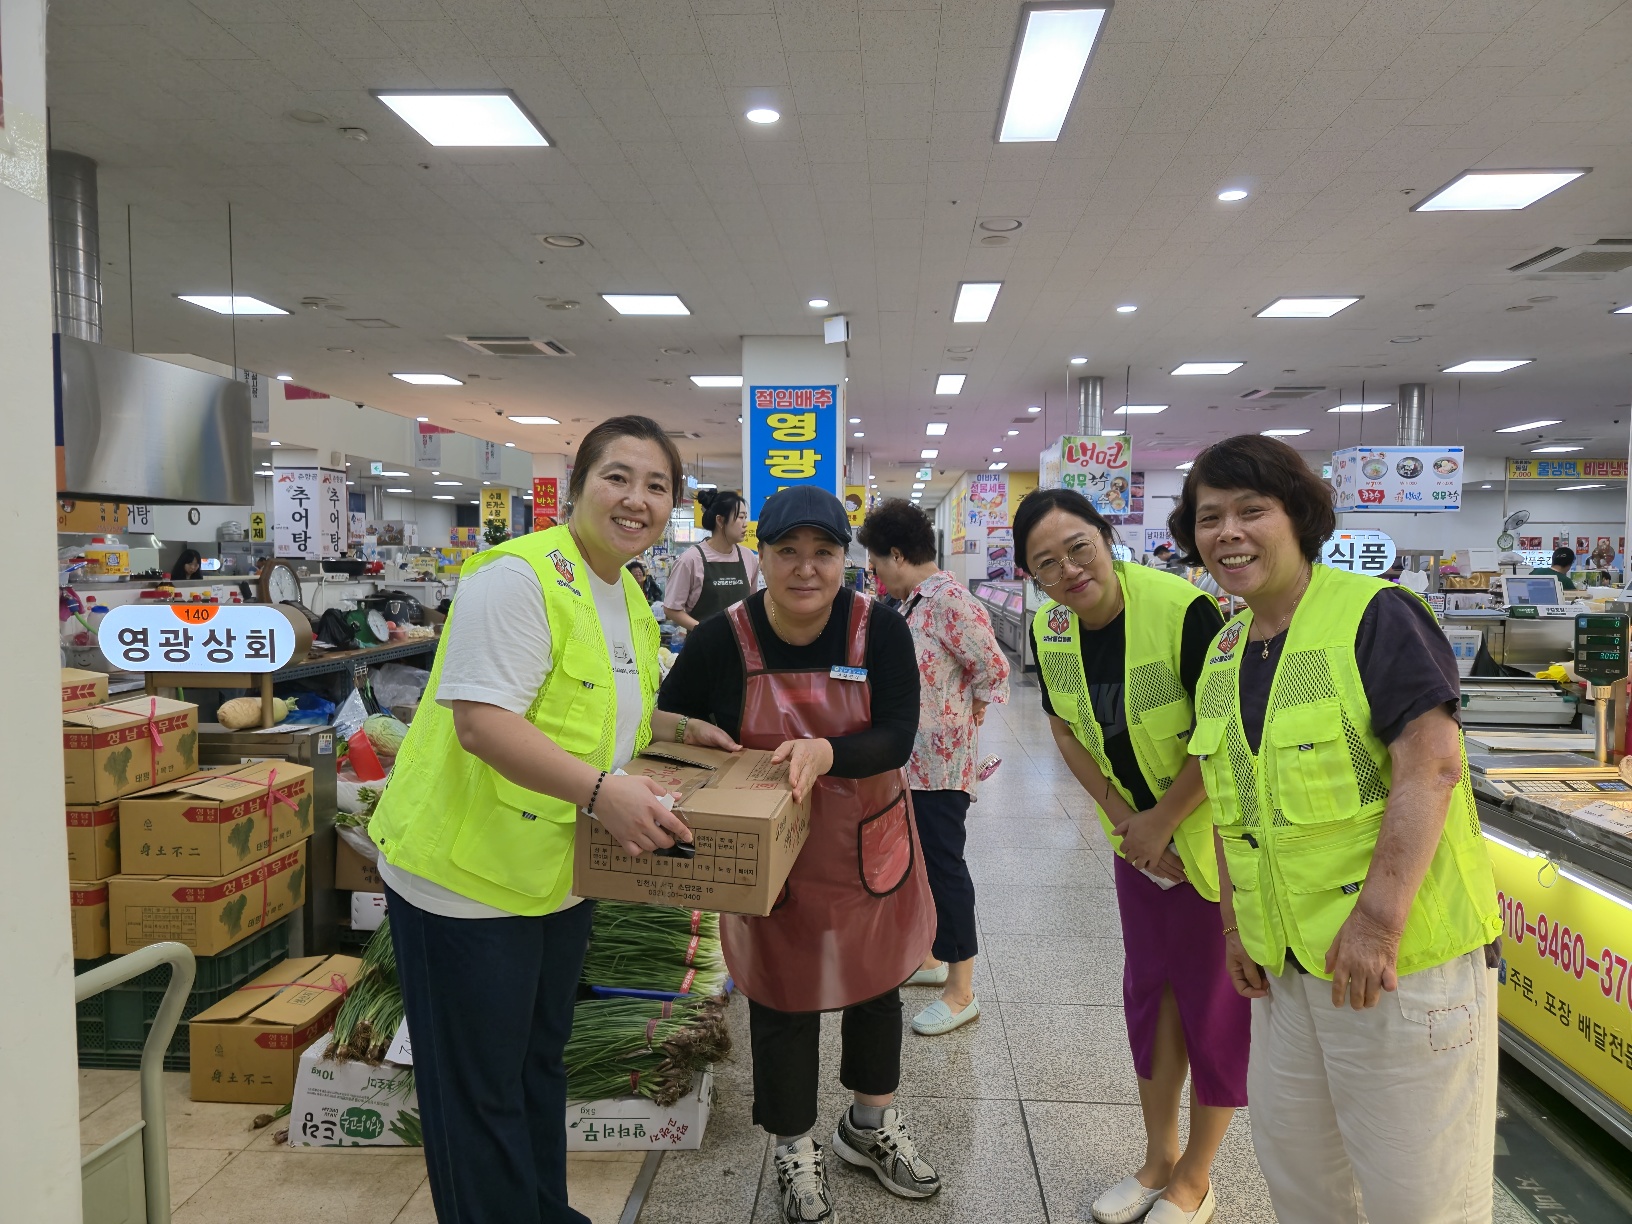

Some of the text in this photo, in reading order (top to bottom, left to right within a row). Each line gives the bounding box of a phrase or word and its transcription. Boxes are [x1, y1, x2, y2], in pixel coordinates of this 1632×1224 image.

[755, 388, 832, 409] 절임배추
[764, 411, 822, 500] 영광
[1066, 441, 1128, 469] 냉면
[970, 482, 1006, 494] 선물세트
[536, 497, 555, 507] 반찬
[252, 515, 264, 540] 수제
[291, 485, 312, 552] 추어탕
[328, 487, 342, 552] 추어탕
[1327, 542, 1388, 571] 식품
[184, 608, 209, 621] 140
[117, 627, 277, 664] 영광상회
[140, 842, 201, 858] 身土不二
[636, 879, 657, 888] 인천시
[1543, 991, 1572, 1027] 포장
[302, 1112, 337, 1141] 드림
[340, 1110, 382, 1137] 청양고추
[582, 1123, 646, 1142] 알타리무
